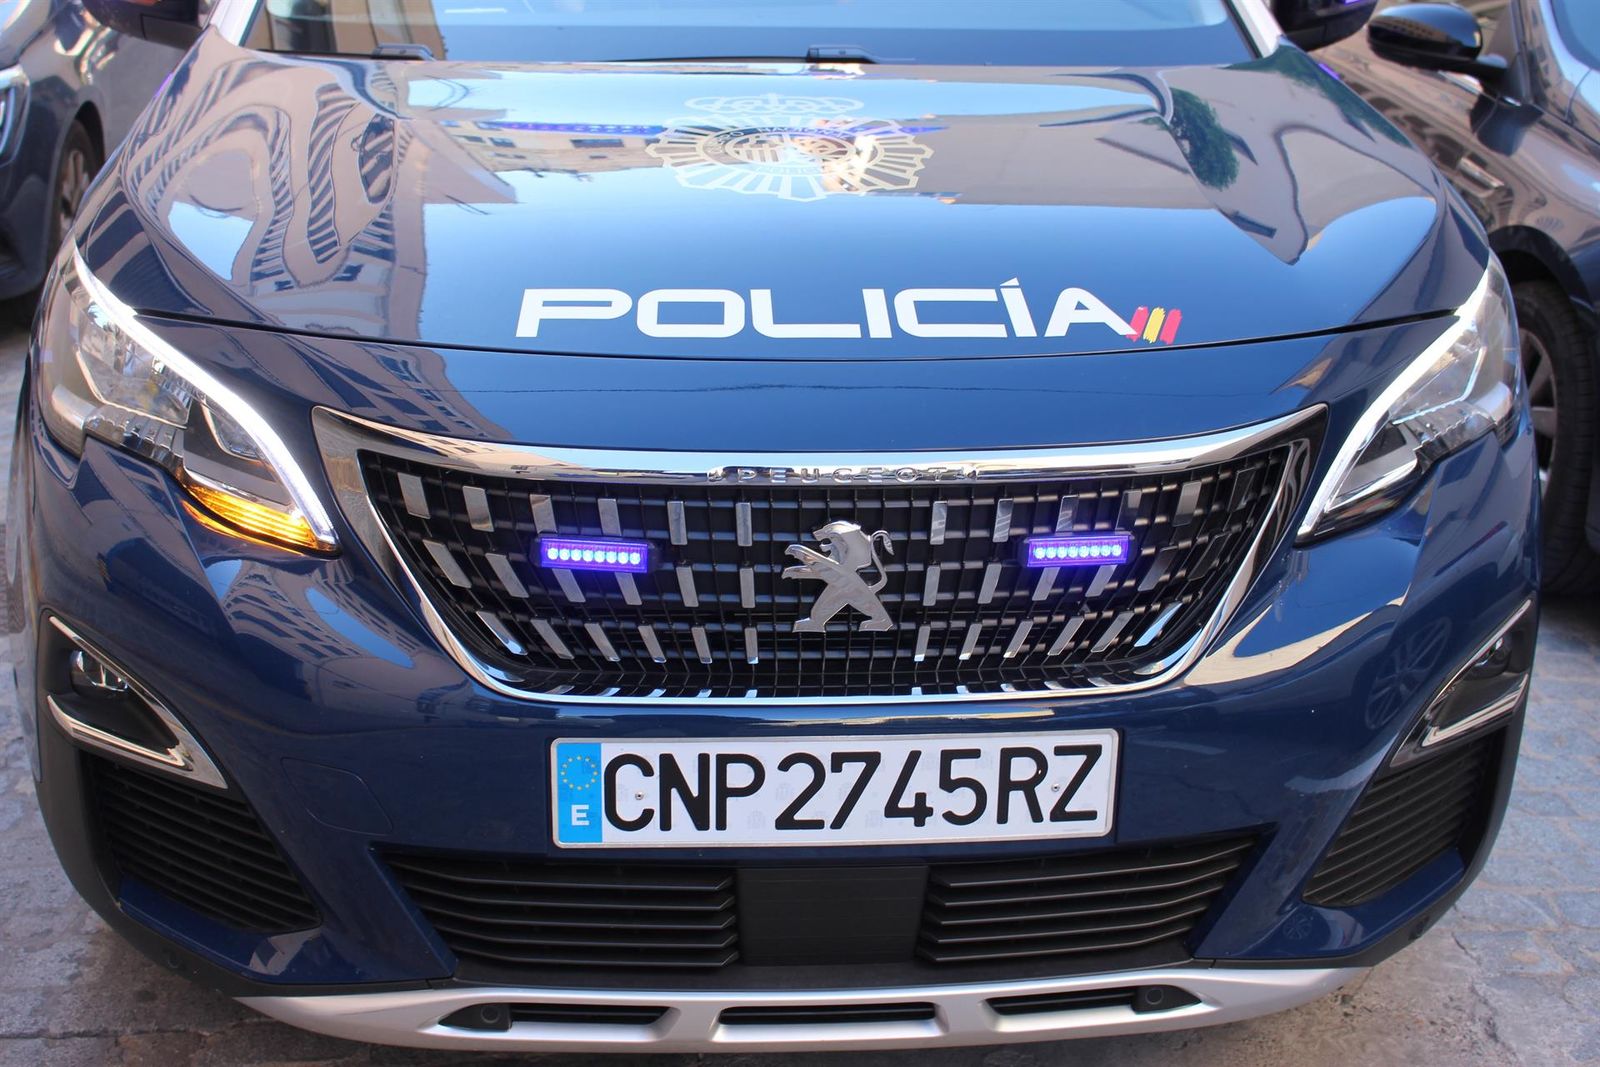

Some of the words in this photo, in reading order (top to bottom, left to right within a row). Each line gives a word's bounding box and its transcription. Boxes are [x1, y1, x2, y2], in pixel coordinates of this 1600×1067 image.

[515, 277, 1137, 338] POLICÍA
[737, 466, 947, 484] PEUGEOT
[571, 804, 589, 826] E
